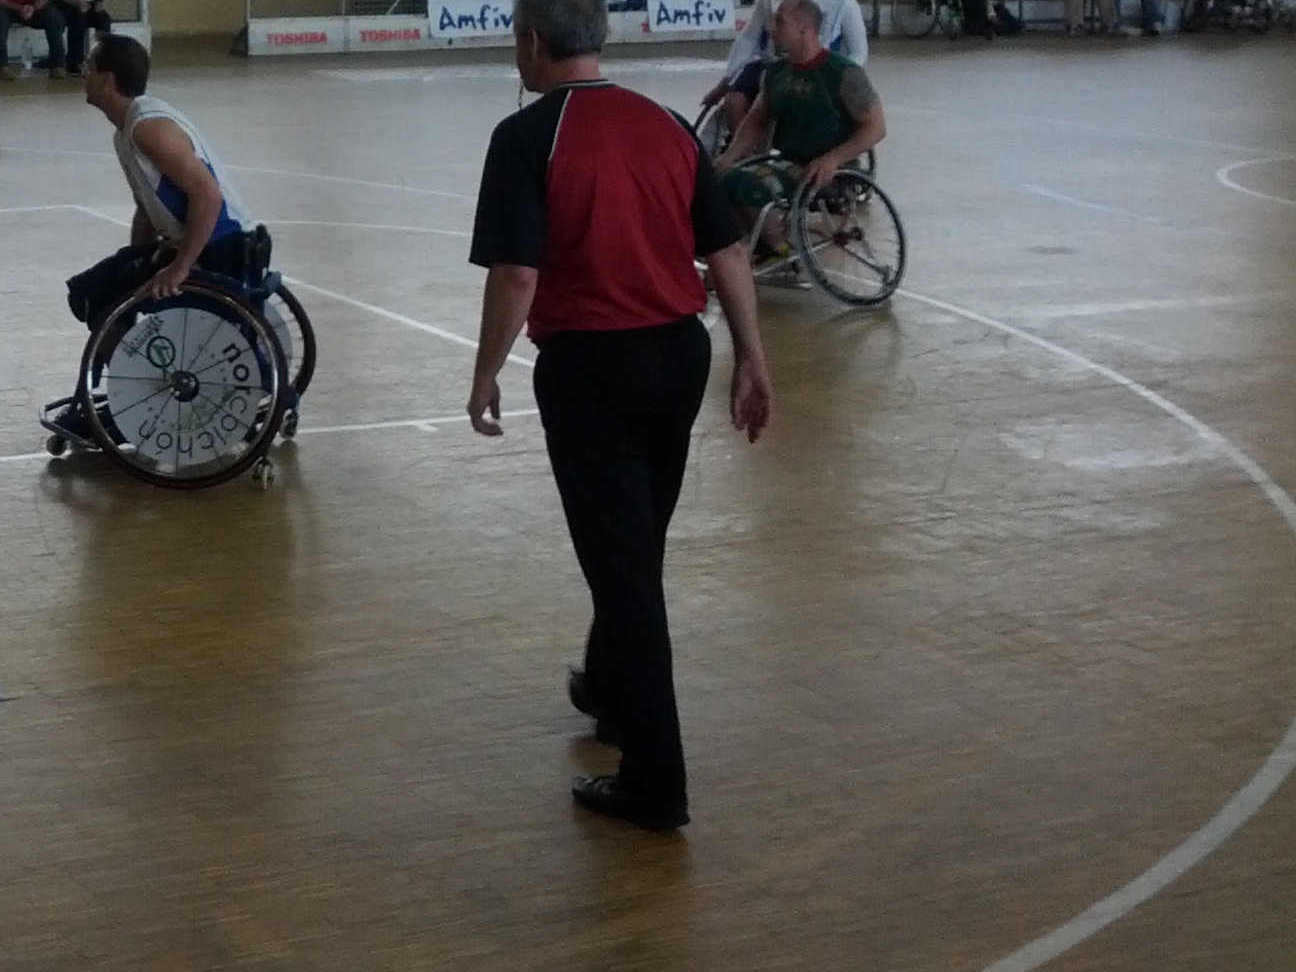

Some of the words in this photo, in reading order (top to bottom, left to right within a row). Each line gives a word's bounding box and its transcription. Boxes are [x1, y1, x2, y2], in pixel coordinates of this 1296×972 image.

[439, 4, 513, 31] Amfiv
[655, 0, 726, 26] Amfiv
[267, 31, 328, 46] TOSHIBA
[359, 28, 421, 43] TOSHIBA
